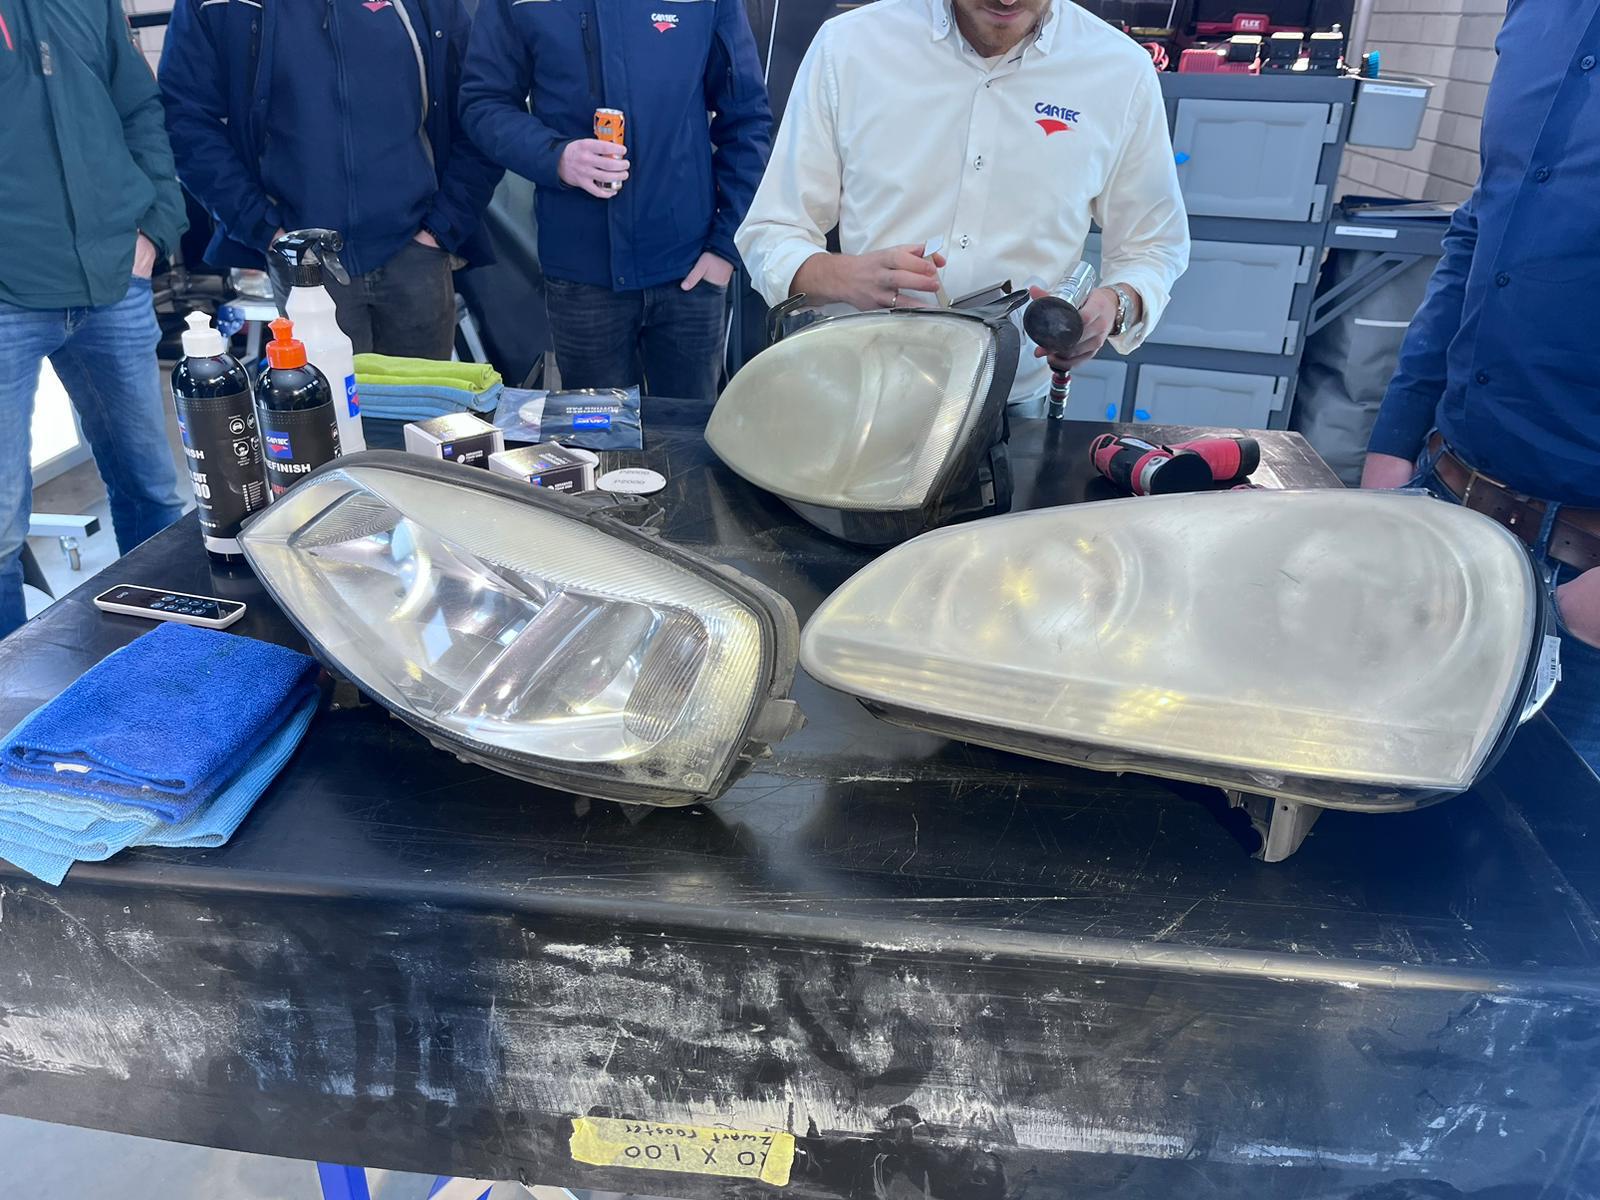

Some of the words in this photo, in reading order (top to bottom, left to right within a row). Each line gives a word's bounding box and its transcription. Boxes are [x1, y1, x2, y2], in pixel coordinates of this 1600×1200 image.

[1241, 19, 1260, 27] FLEX
[1034, 102, 1081, 123] CARTEC
[266, 436, 289, 446] CARTEC
[266, 460, 312, 474] EFINISH
[625, 1144, 680, 1162] 1.00
